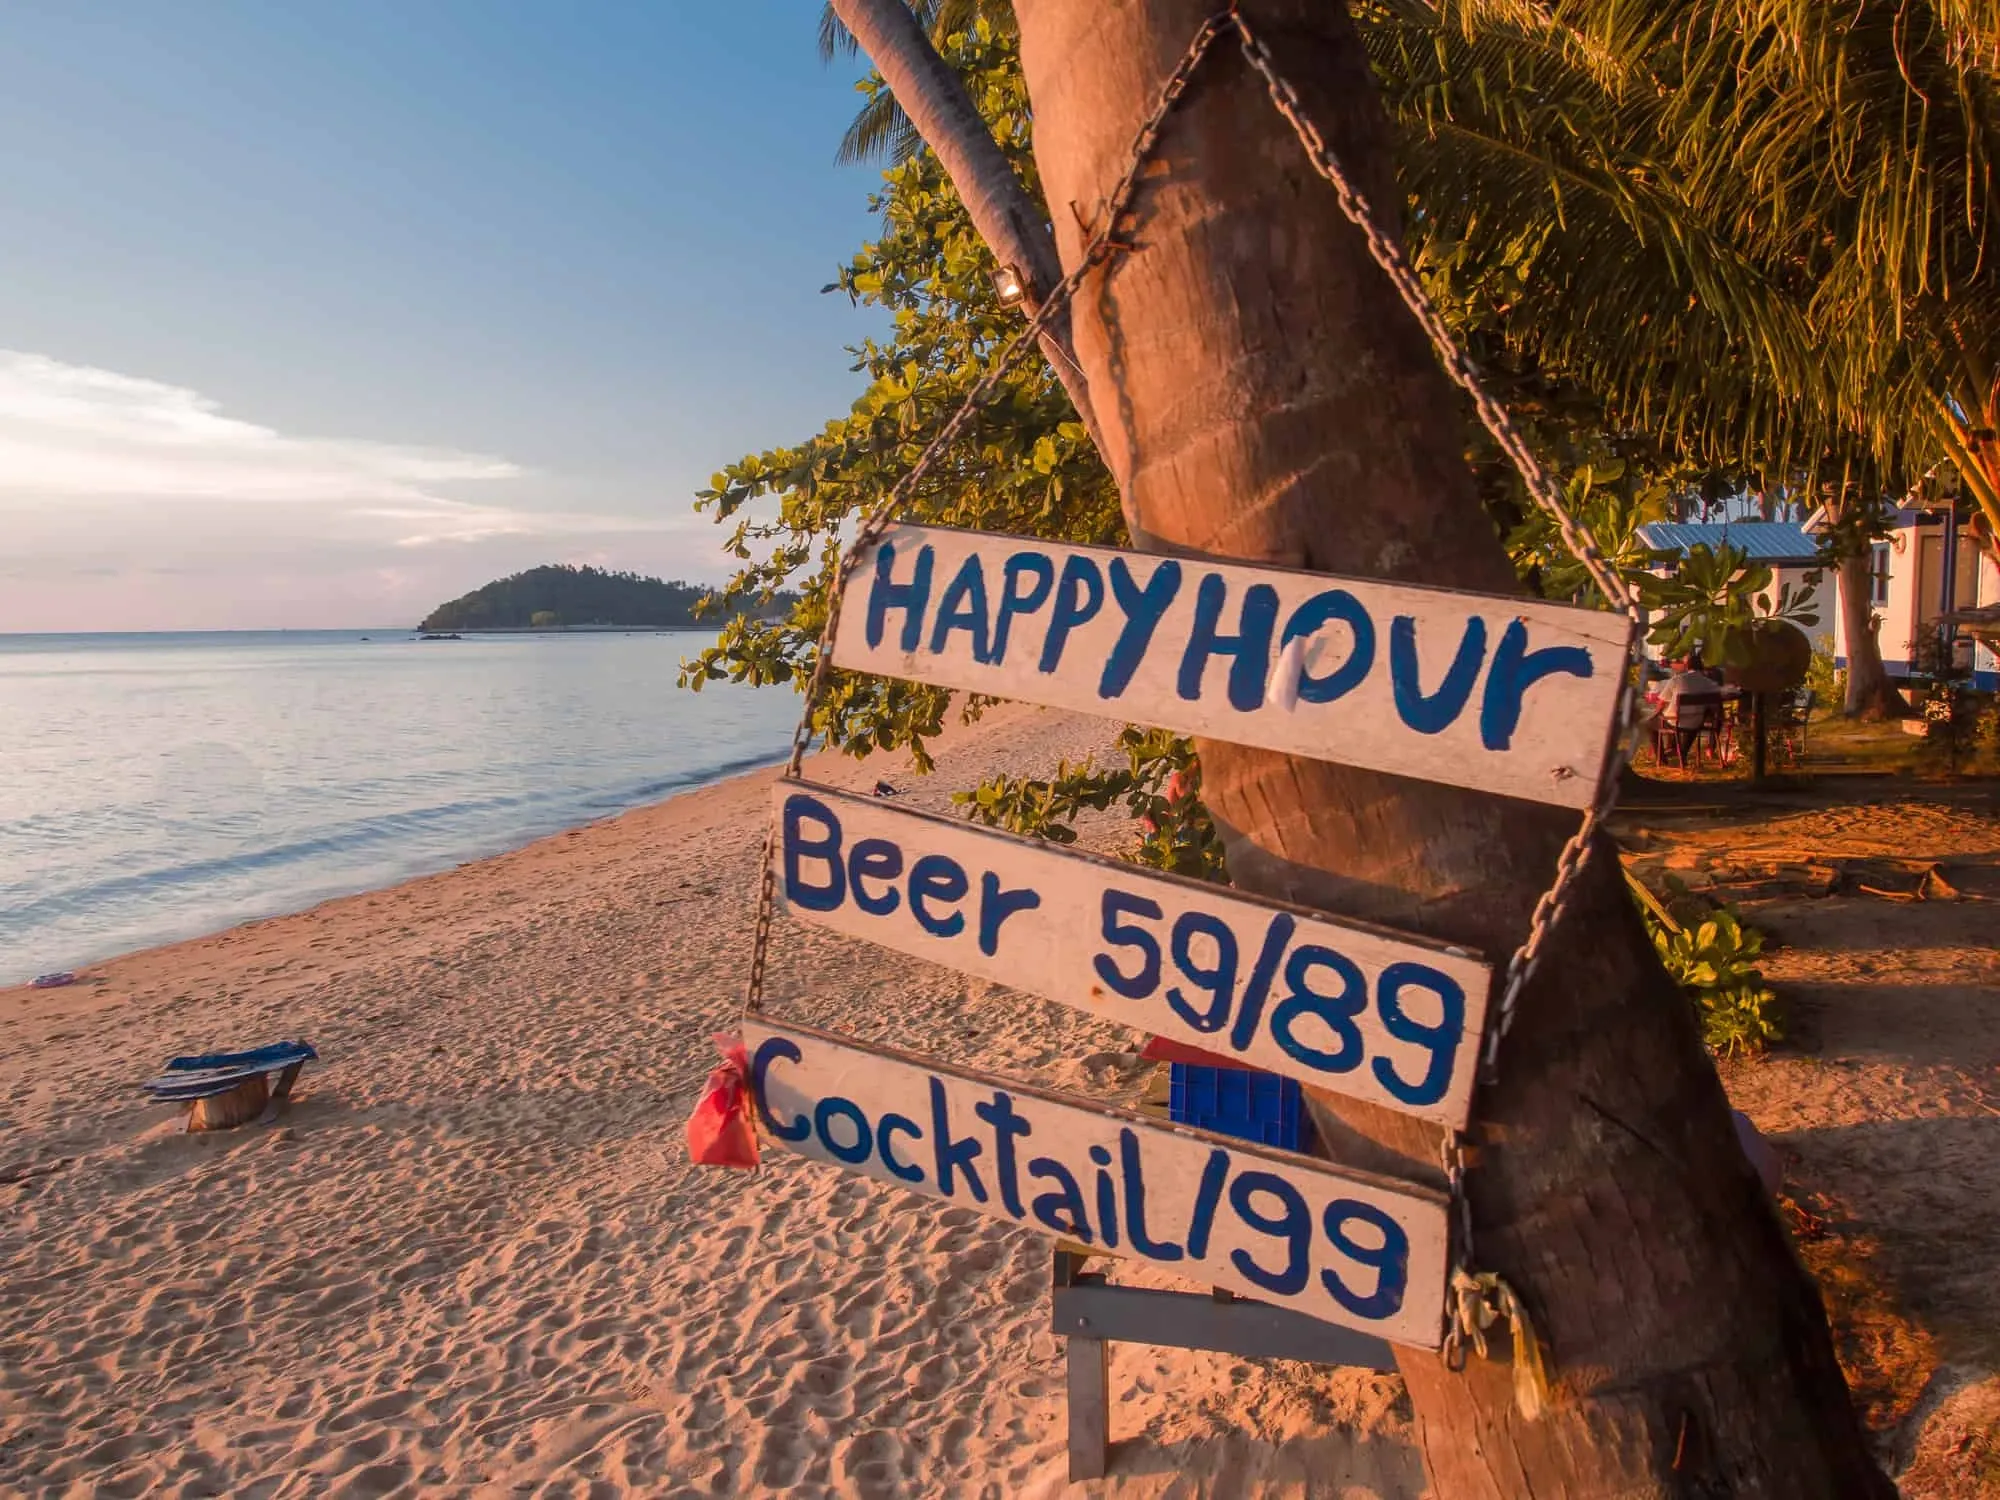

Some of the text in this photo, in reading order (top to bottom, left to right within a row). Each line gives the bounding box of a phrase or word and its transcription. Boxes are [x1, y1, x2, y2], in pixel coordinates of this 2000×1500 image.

[865, 540, 1181, 699] HAPPY
[782, 794, 1466, 1104] Beer 59/89
